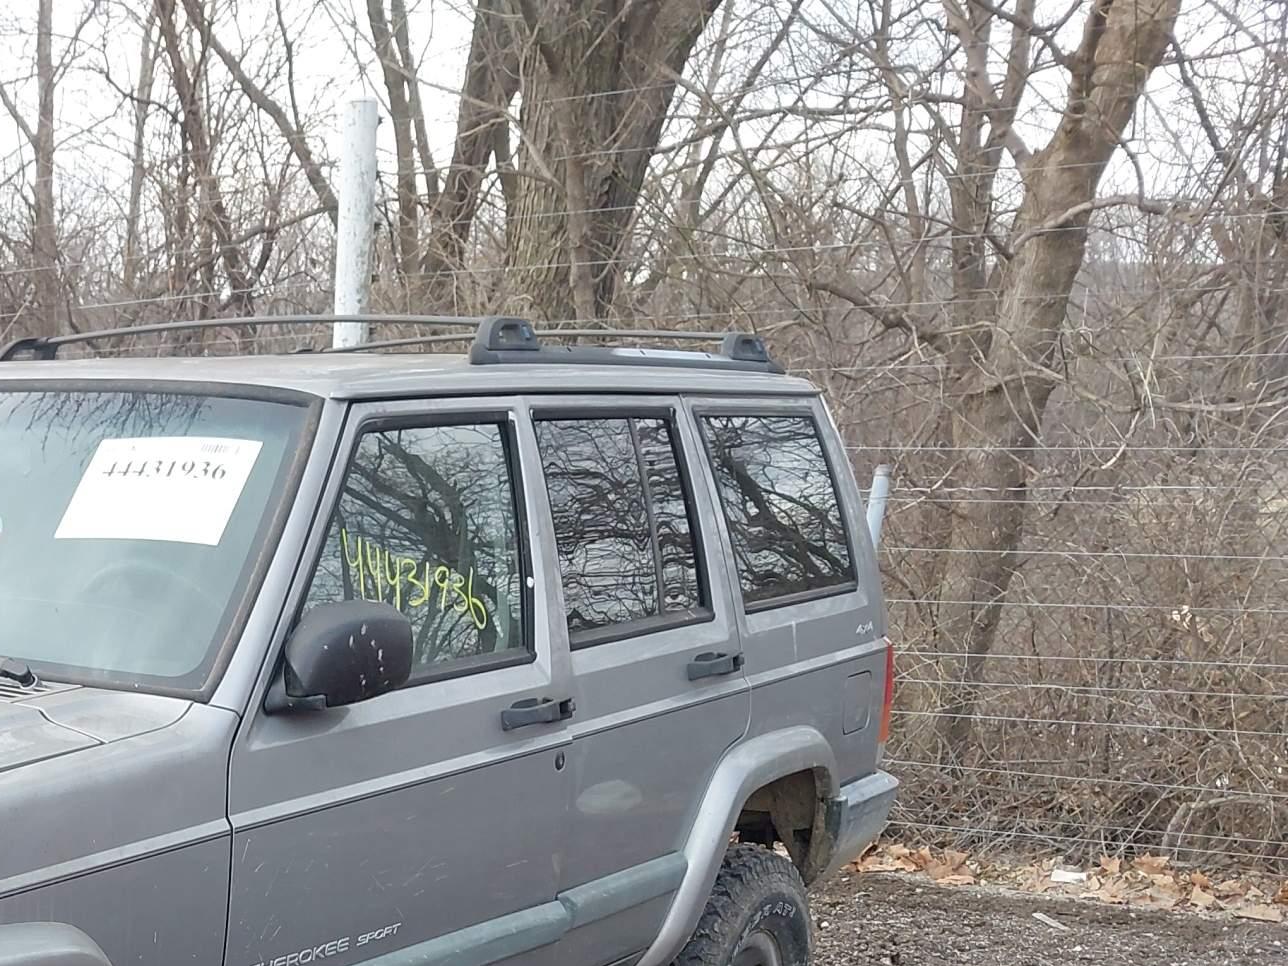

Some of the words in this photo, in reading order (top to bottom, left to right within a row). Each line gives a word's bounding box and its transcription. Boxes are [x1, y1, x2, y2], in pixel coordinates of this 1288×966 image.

[102, 460, 227, 480] 44431936
[341, 527, 487, 630] 44431936
[355, 922, 402, 947] SPORT
